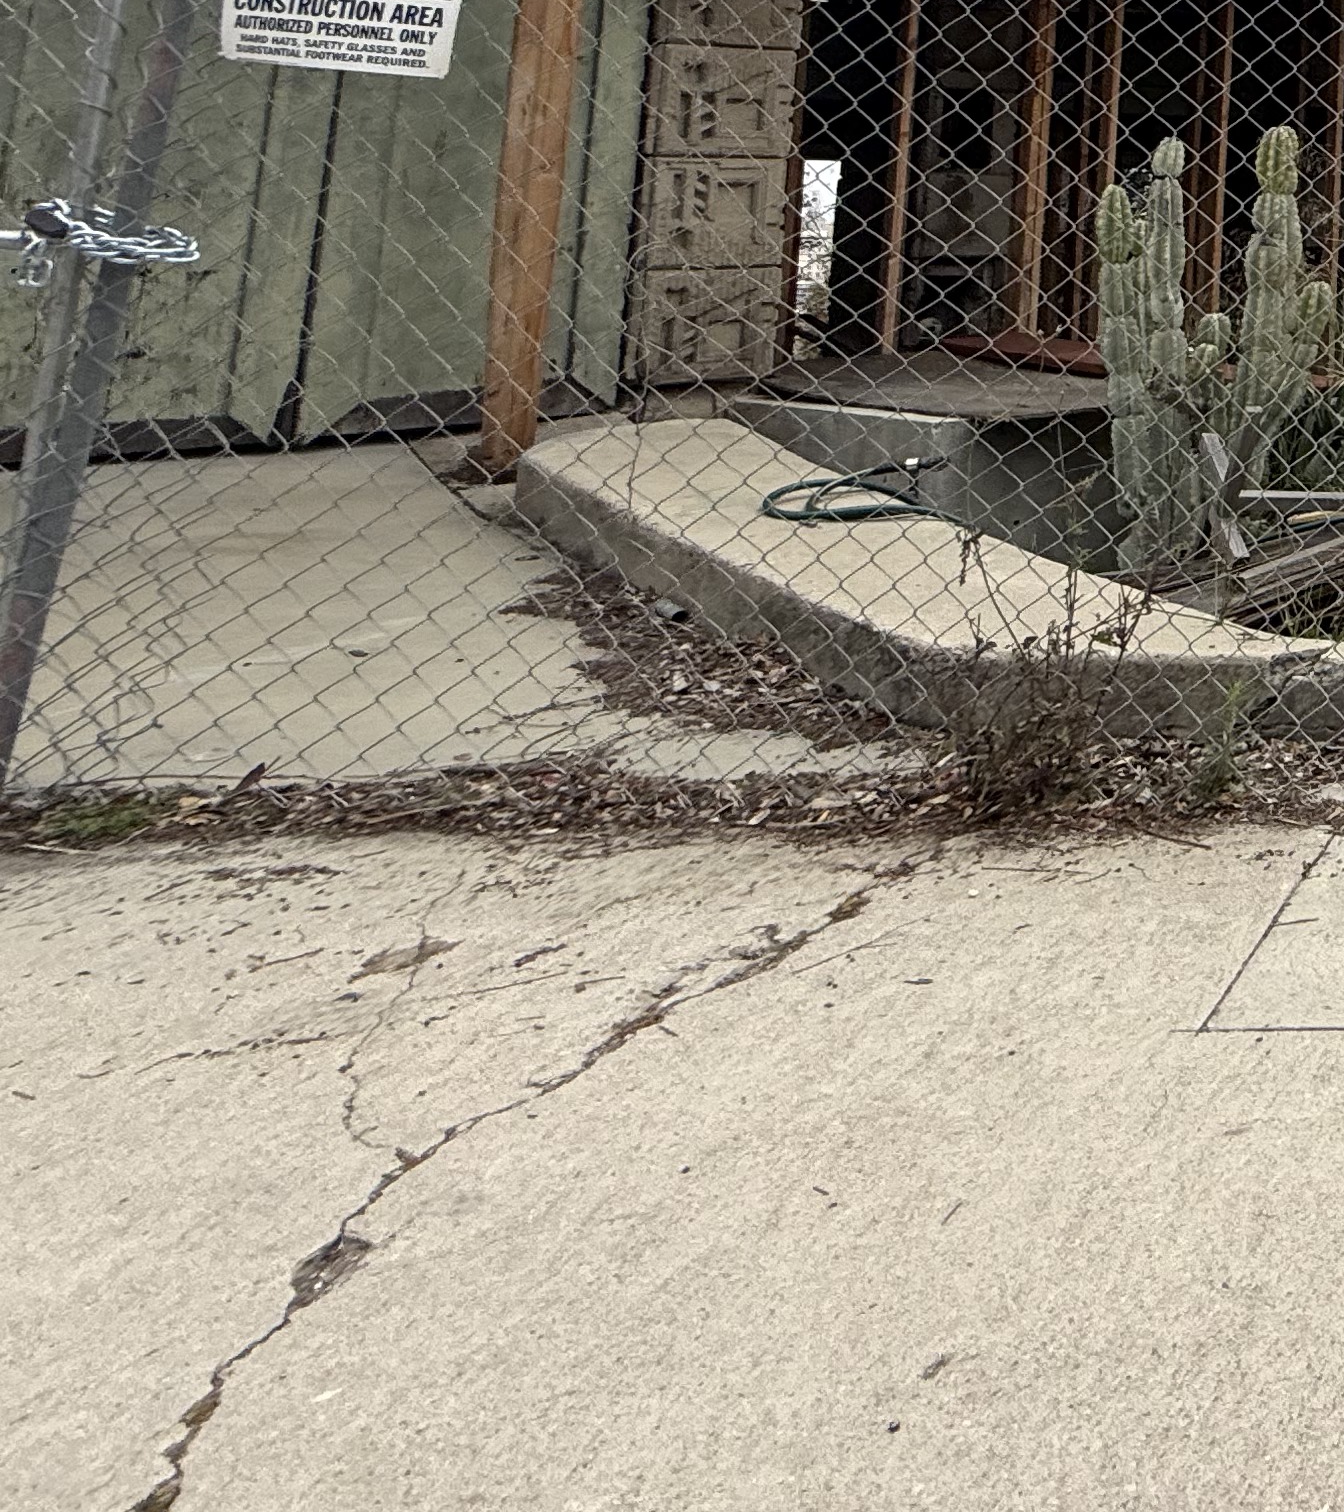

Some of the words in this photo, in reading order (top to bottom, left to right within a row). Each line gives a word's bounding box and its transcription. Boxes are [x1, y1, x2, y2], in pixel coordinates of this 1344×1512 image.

[389, 3, 444, 28] AREA
[234, 14, 313, 35] AUTHORIZED
[317, 21, 395, 42] PERSONNEL
[400, 28, 438, 45] ONLY
[235, 44, 301, 57] SUBSTANTIAL
[305, 50, 363, 63] FOOTWEAR
[366, 55, 430, 68] REQUIRED.
[240, 33, 268, 44] HARD
[272, 37, 301, 48] HATS,
[304, 39, 345, 51] SAFETY
[346, 42, 397, 55] GLASSES
[400, 47, 426, 57] AND
